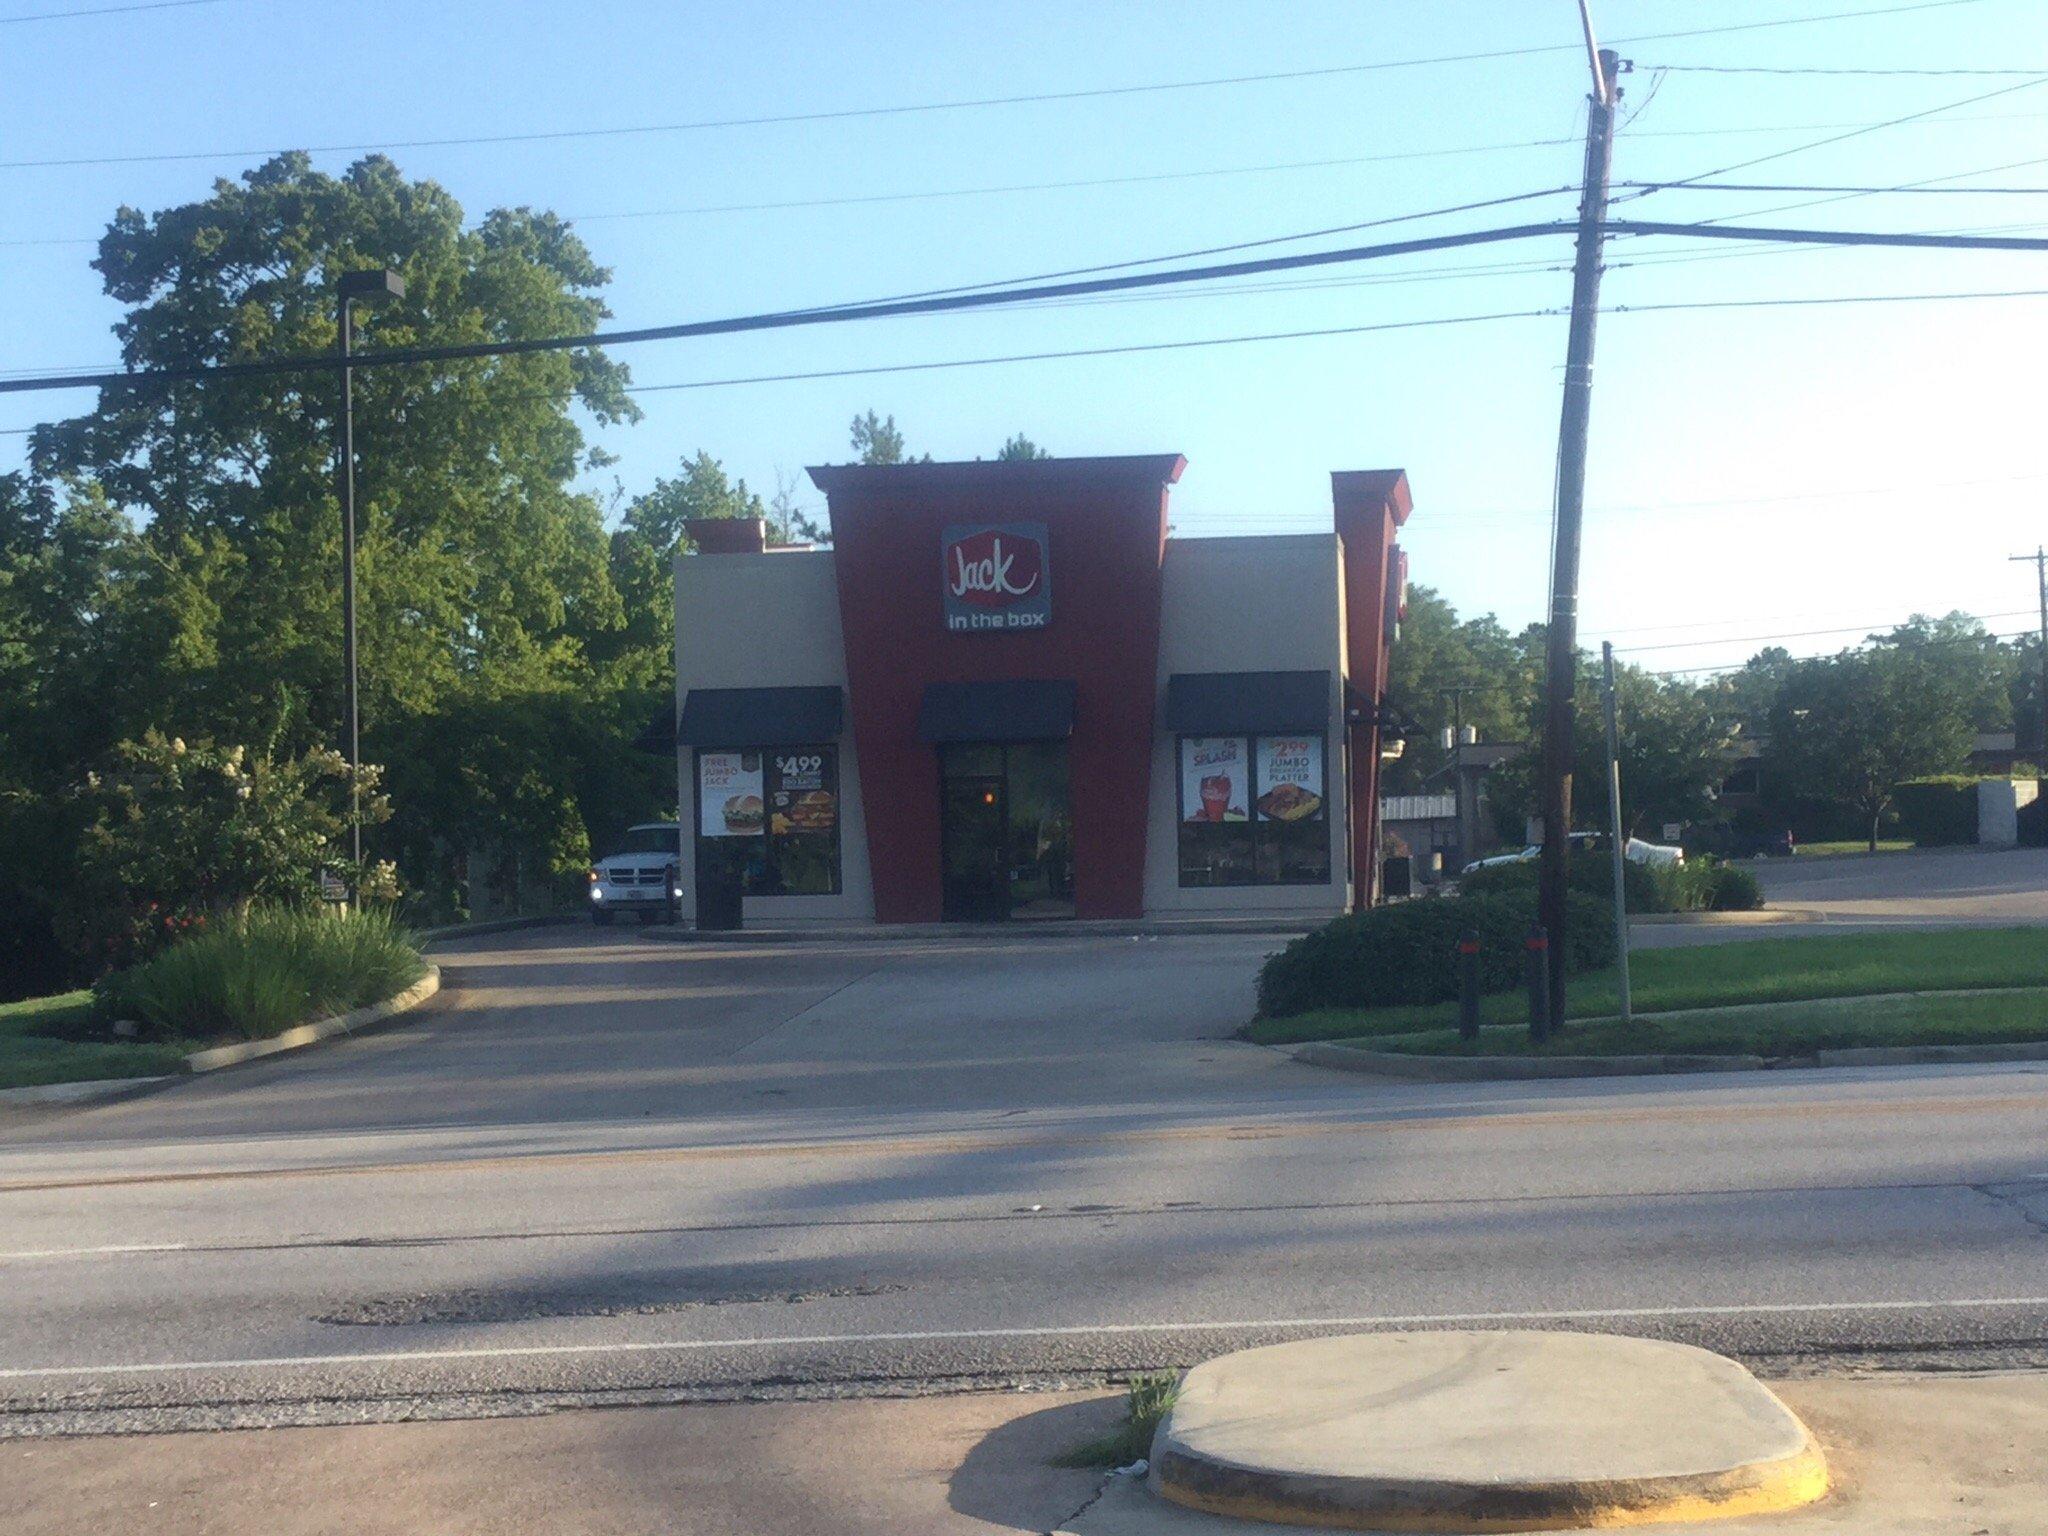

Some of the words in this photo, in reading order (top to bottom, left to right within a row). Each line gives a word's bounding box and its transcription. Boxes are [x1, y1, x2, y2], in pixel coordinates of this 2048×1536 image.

[951, 538, 1039, 596] Jack
[949, 614, 968, 629] in
[971, 613, 1004, 628] the
[1008, 612, 1045, 626] box
[1270, 757, 1310, 767] JUMBO
